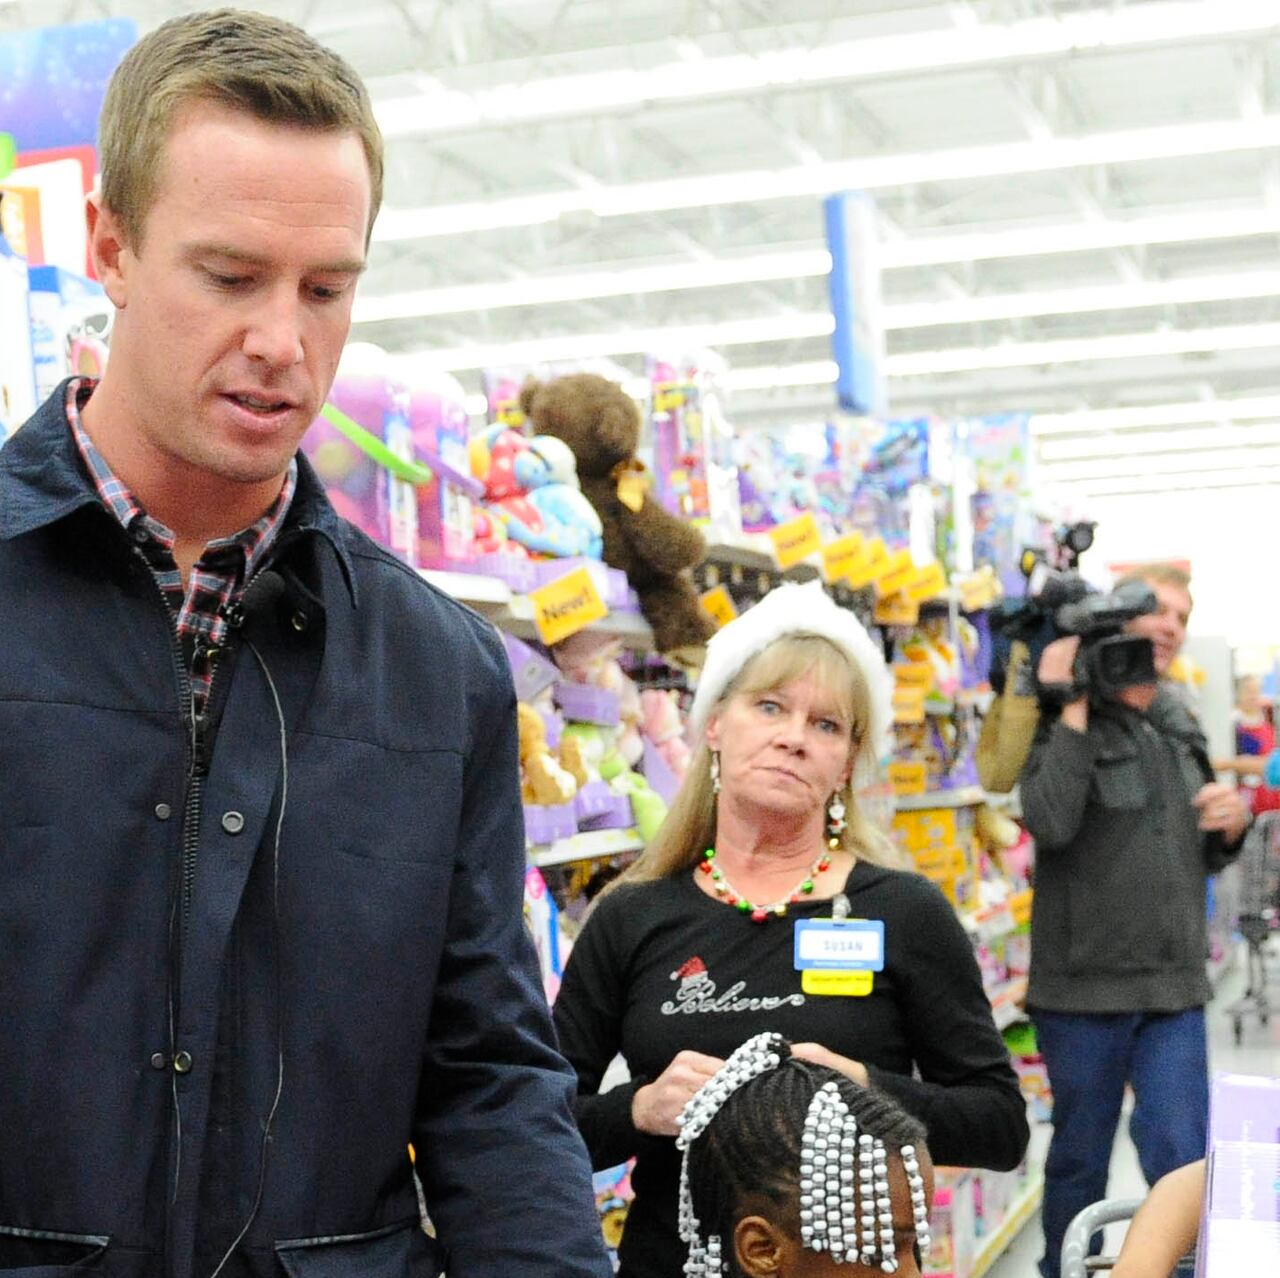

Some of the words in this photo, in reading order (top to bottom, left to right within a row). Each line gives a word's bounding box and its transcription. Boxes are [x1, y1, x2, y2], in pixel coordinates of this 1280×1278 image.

[542, 590, 595, 627] New!
[823, 940, 864, 952] SUSAN
[661, 980, 805, 1015] Believe
